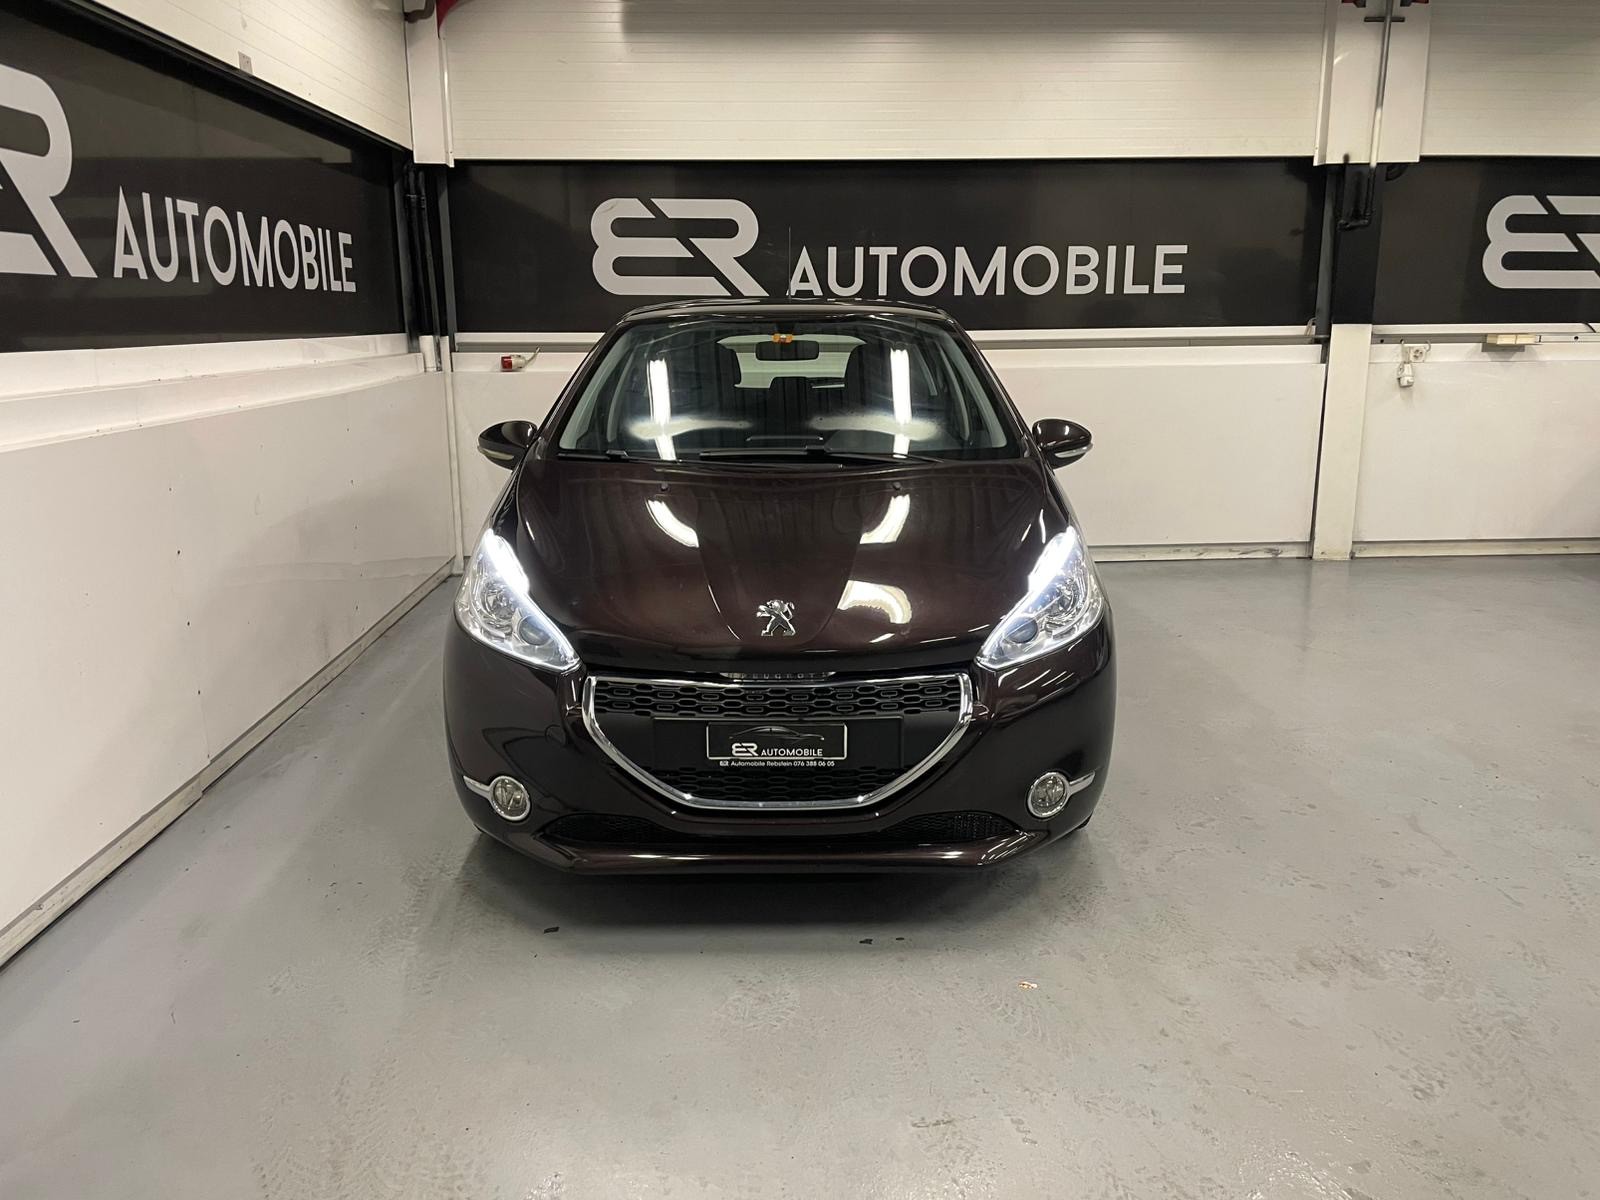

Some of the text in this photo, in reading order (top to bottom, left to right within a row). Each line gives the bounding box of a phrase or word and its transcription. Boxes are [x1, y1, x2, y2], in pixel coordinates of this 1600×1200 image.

[0, 63, 357, 293] R AUTOMOBILE
[786, 244, 1188, 297] AUTOMOBILE
[760, 748, 823, 757] AUTOMOBILE
